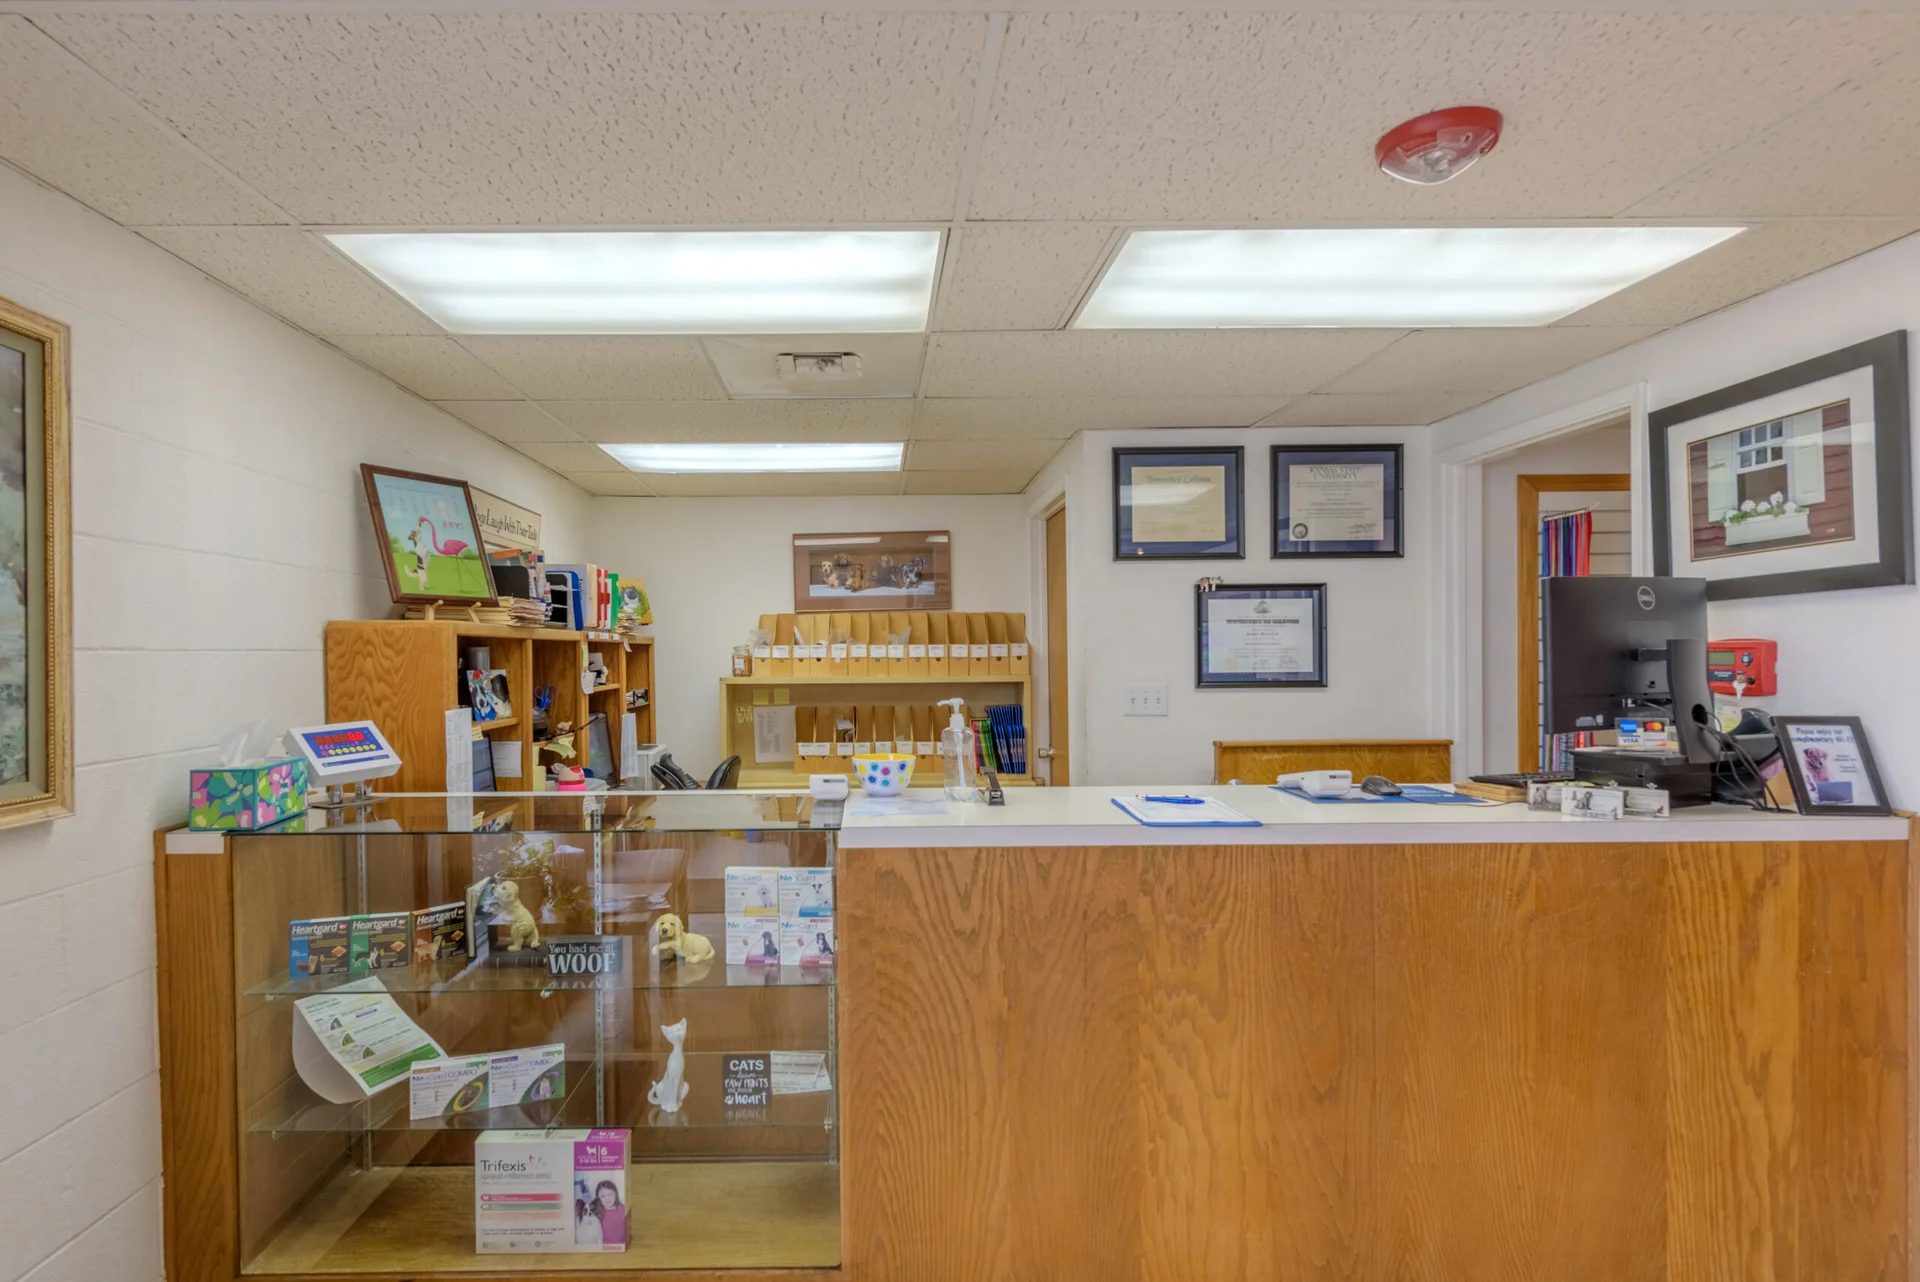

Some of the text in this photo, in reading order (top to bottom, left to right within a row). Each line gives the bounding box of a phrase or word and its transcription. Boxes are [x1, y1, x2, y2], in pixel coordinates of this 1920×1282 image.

[352, 917, 398, 930] Heartgard
[417, 909, 457, 925] Heartgard
[291, 922, 339, 936] Heartgard
[548, 944, 566, 953] You
[568, 943, 587, 953] had
[549, 953, 616, 973] WOOF
[730, 1059, 764, 1071] CATS
[724, 1078, 742, 1089] PAW
[735, 1091, 767, 1105] heart
[600, 1146, 608, 1156] 6
[480, 1159, 527, 1172] Trifexis
